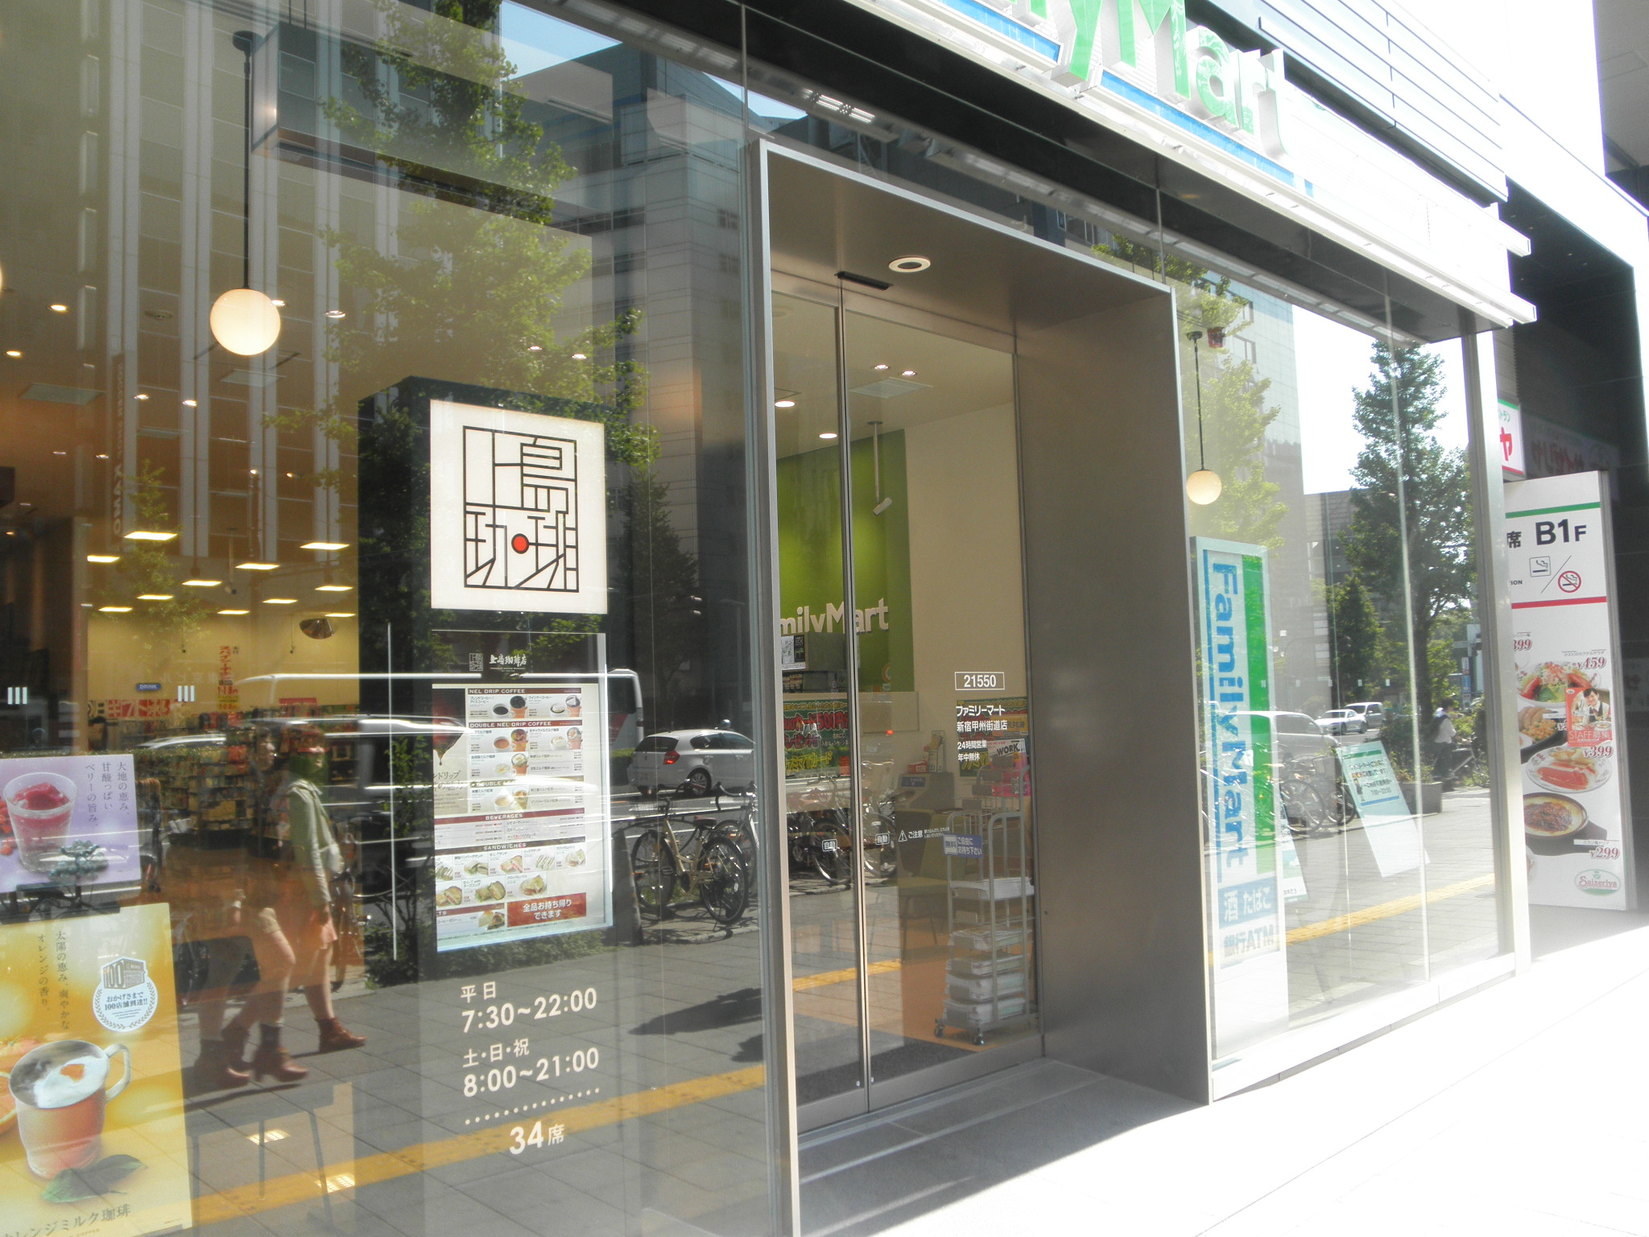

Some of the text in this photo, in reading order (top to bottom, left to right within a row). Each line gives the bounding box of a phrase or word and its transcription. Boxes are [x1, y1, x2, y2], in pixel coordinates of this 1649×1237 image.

[1507, 519, 1587, 549] 席 B1F
[963, 674, 997, 688] 21550
[955, 704, 1006, 717] ファミリーマート
[1213, 563, 1249, 868] FamilyMart
[956, 719, 1008, 732] 新宿甲州街道店
[957, 739, 987, 750] 24時間営業
[996, 742, 1020, 756] WORK
[957, 752, 980, 762] 年中無休
[1583, 745, 1613, 759] ¥399
[101, 762, 113, 811] 甘酸っぱい
[117, 761, 131, 816] 大地の恵み、
[86, 763, 99, 827] ベリーの旨み。
[1590, 847, 1620, 860] ¥299
[1579, 875, 1618, 889] Saizeriya
[523, 899, 572, 912] 全品お持ち帰り
[1224, 886, 1272, 922] 酒 たばこ
[534, 910, 561, 920] できます
[106, 991, 144, 1003] おかげさまで
[460, 981, 497, 1004] 平日
[509, 1120, 566, 1156] 34席
